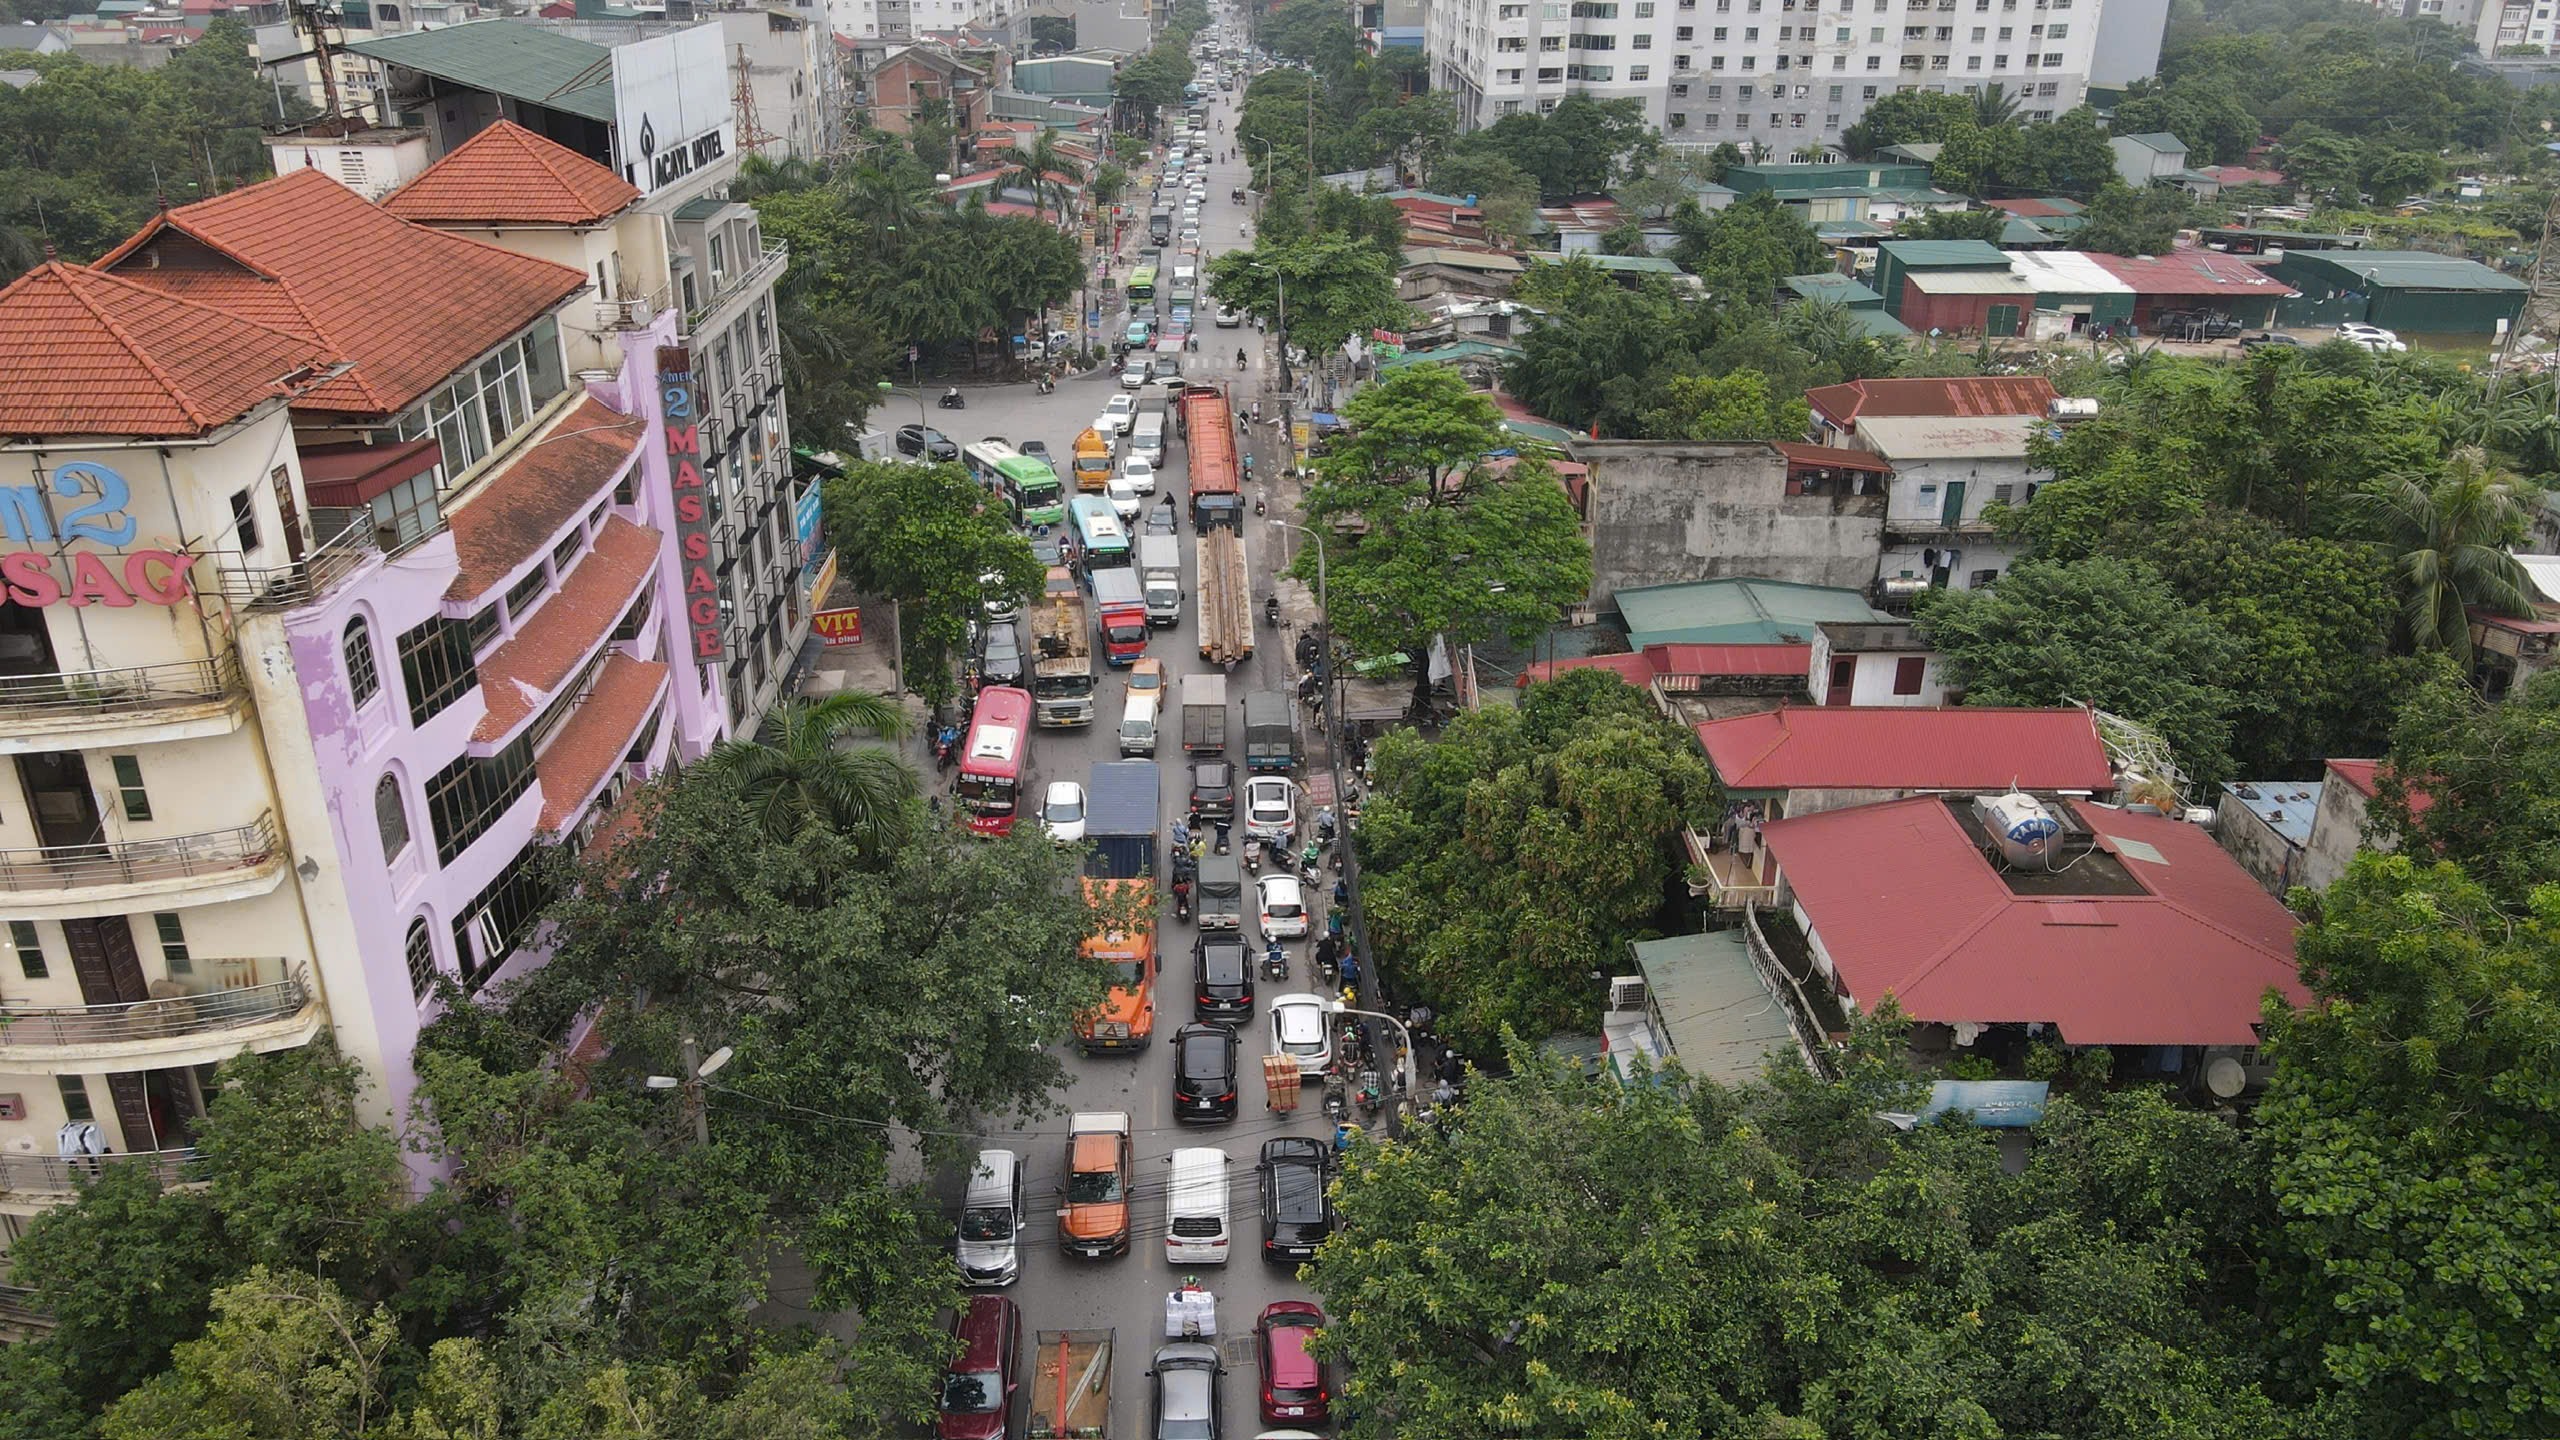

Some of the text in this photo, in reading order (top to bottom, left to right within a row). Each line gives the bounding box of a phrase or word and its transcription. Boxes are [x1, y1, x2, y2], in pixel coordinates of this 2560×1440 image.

[692, 129, 725, 170] HOTEL
[664, 387, 690, 417] 2
[0, 549, 196, 608] SAG
